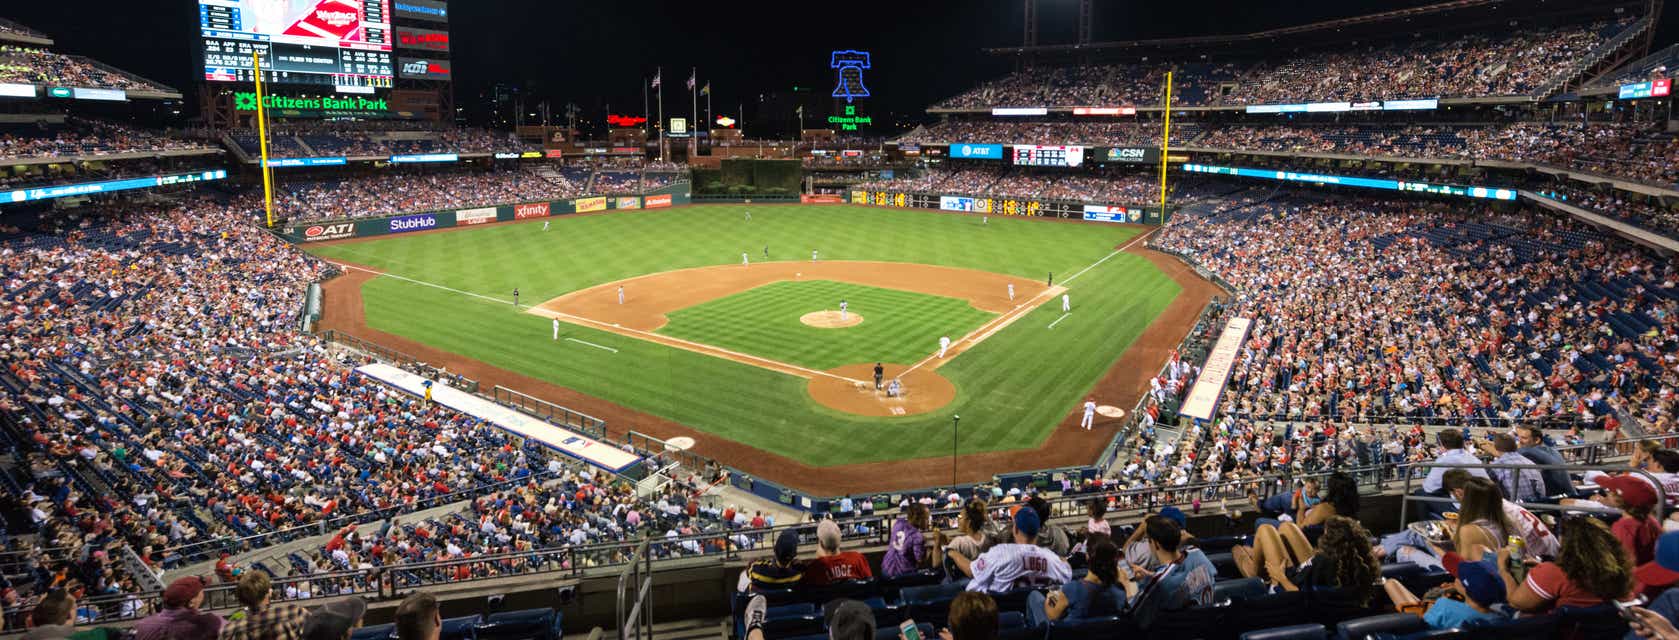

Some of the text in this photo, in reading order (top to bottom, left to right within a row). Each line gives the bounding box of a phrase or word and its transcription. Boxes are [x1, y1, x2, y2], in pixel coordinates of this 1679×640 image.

[262, 96, 388, 110] Citizens Bank Park
[972, 147, 990, 155] AT&T
[1122, 149, 1145, 157] CSN
[517, 204, 548, 218] xfinity
[322, 223, 354, 235] ATI
[390, 215, 435, 231] StubHub
[1023, 555, 1048, 573] LUGO
